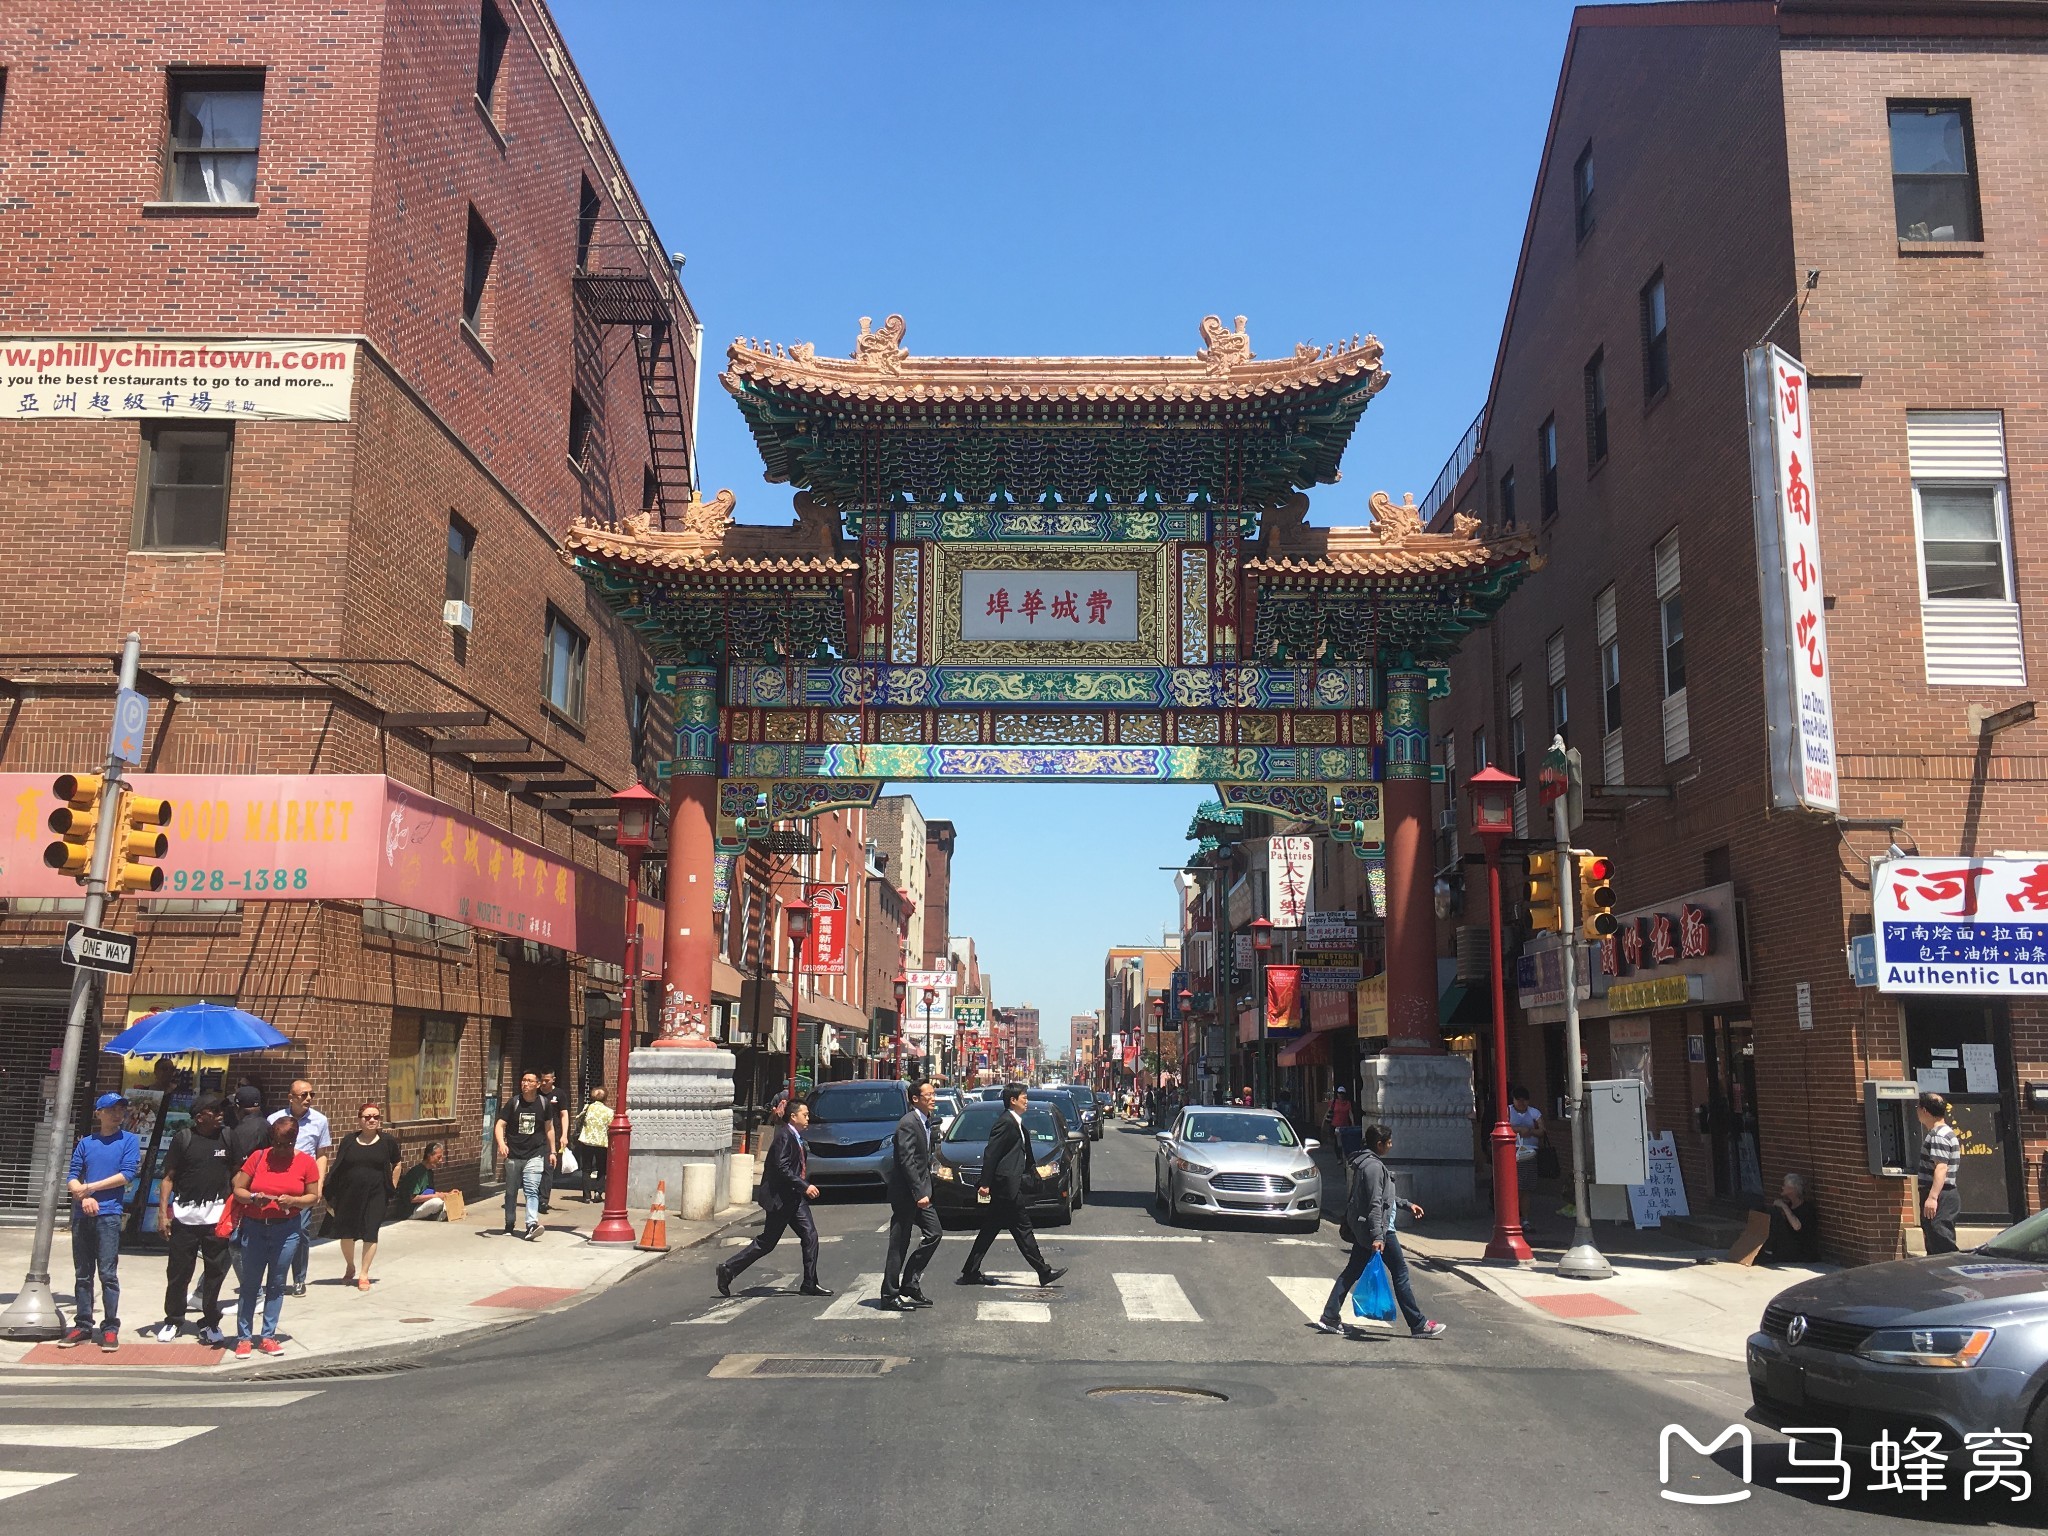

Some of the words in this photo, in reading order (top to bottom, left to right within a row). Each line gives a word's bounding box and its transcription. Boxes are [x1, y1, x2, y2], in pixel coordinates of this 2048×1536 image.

[0, 343, 346, 373] w.phillychinatown.com
[8, 375, 33, 387] you
[38, 374, 61, 385] the
[66, 374, 98, 385] best
[103, 374, 187, 387] restaurants
[193, 376, 207, 387] to
[212, 378, 230, 389] go
[235, 376, 249, 387] to
[254, 376, 281, 387] and
[285, 379, 334, 387] more...
[17, 391, 212, 413] 亞洲超級市場
[1780, 366, 1824, 678] 河南小吃
[244, 800, 354, 843] MARKET
[1270, 851, 1312, 861] Pastries
[1278, 861, 1306, 916] 大家樂
[82, 939, 102, 957] ONE
[105, 943, 128, 961] WAY
[1888, 966, 2000, 985] Authentic
